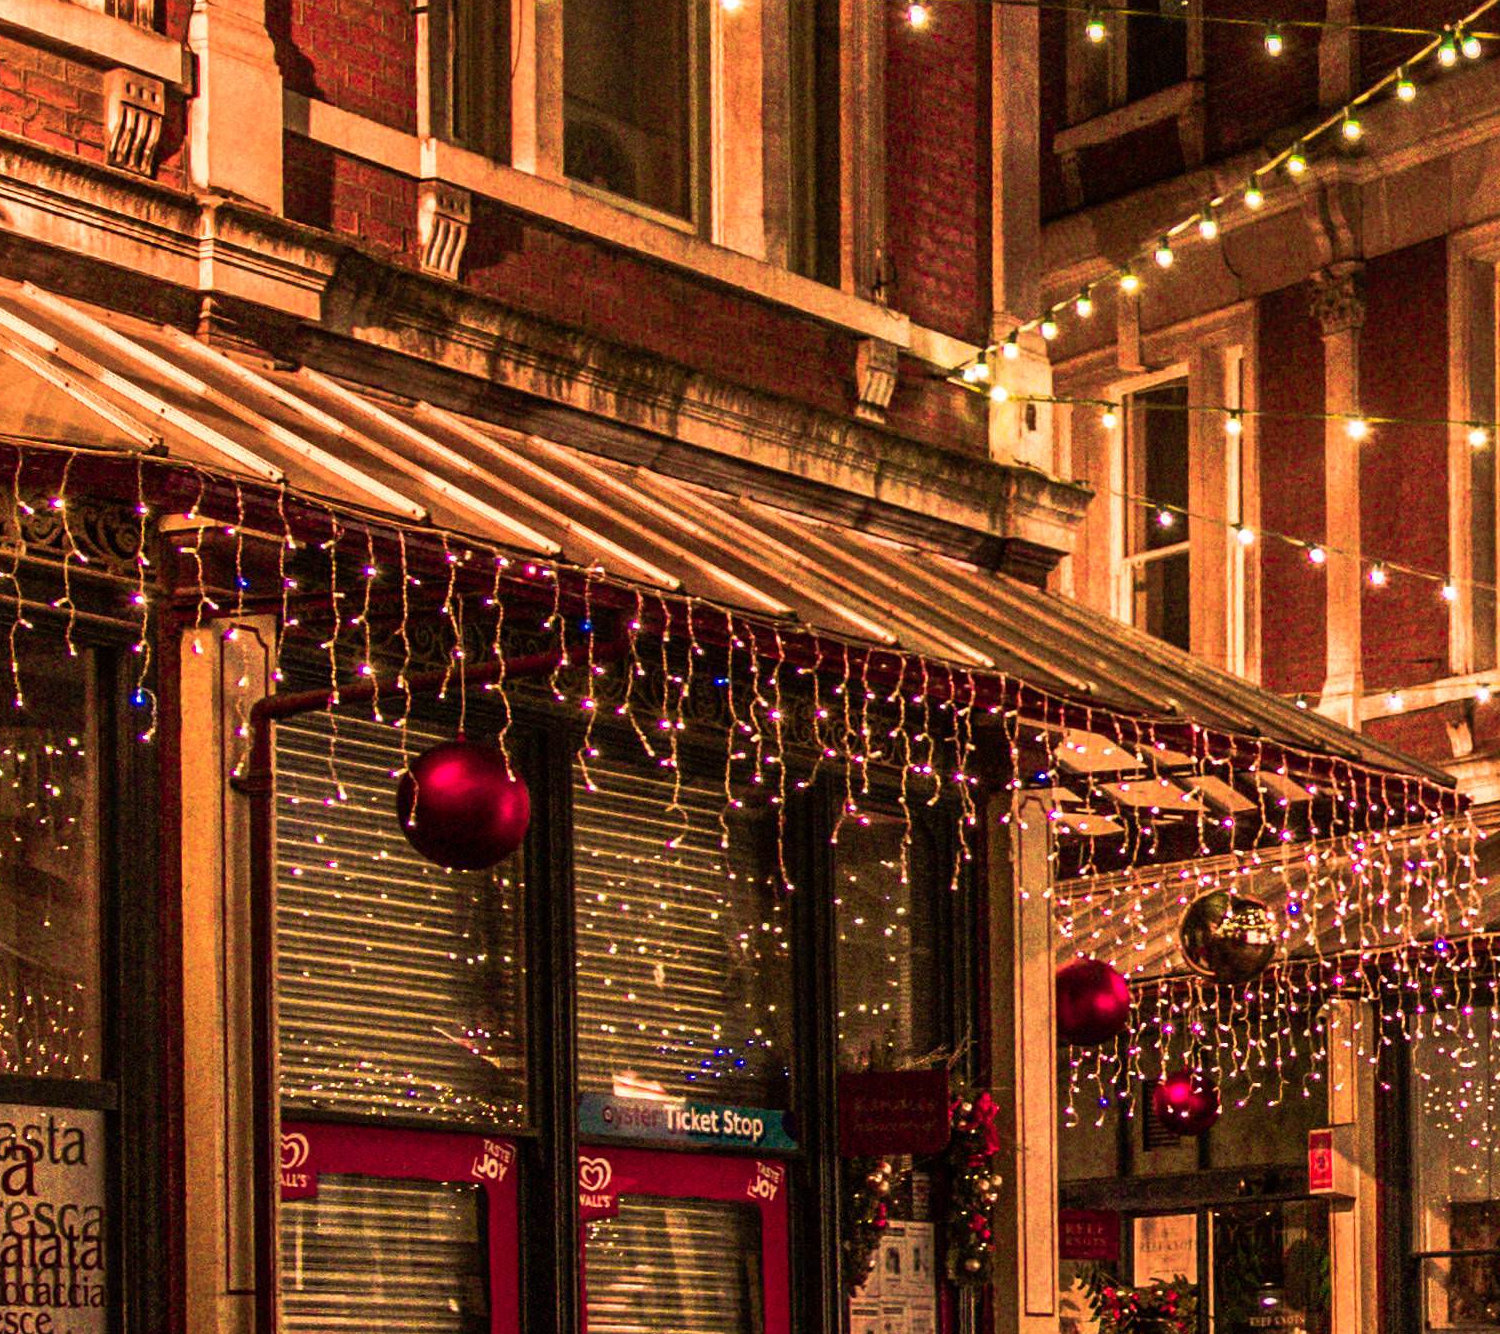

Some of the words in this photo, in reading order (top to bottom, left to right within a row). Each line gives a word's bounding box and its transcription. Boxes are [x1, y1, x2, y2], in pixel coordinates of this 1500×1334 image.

[664, 1104, 721, 1134] Ticket
[723, 1110, 765, 1144] Stop
[483, 1138, 512, 1164] TASTE
[477, 1154, 509, 1183] JOY
[755, 1161, 781, 1183] TASTE
[751, 1177, 778, 1202] JOY
